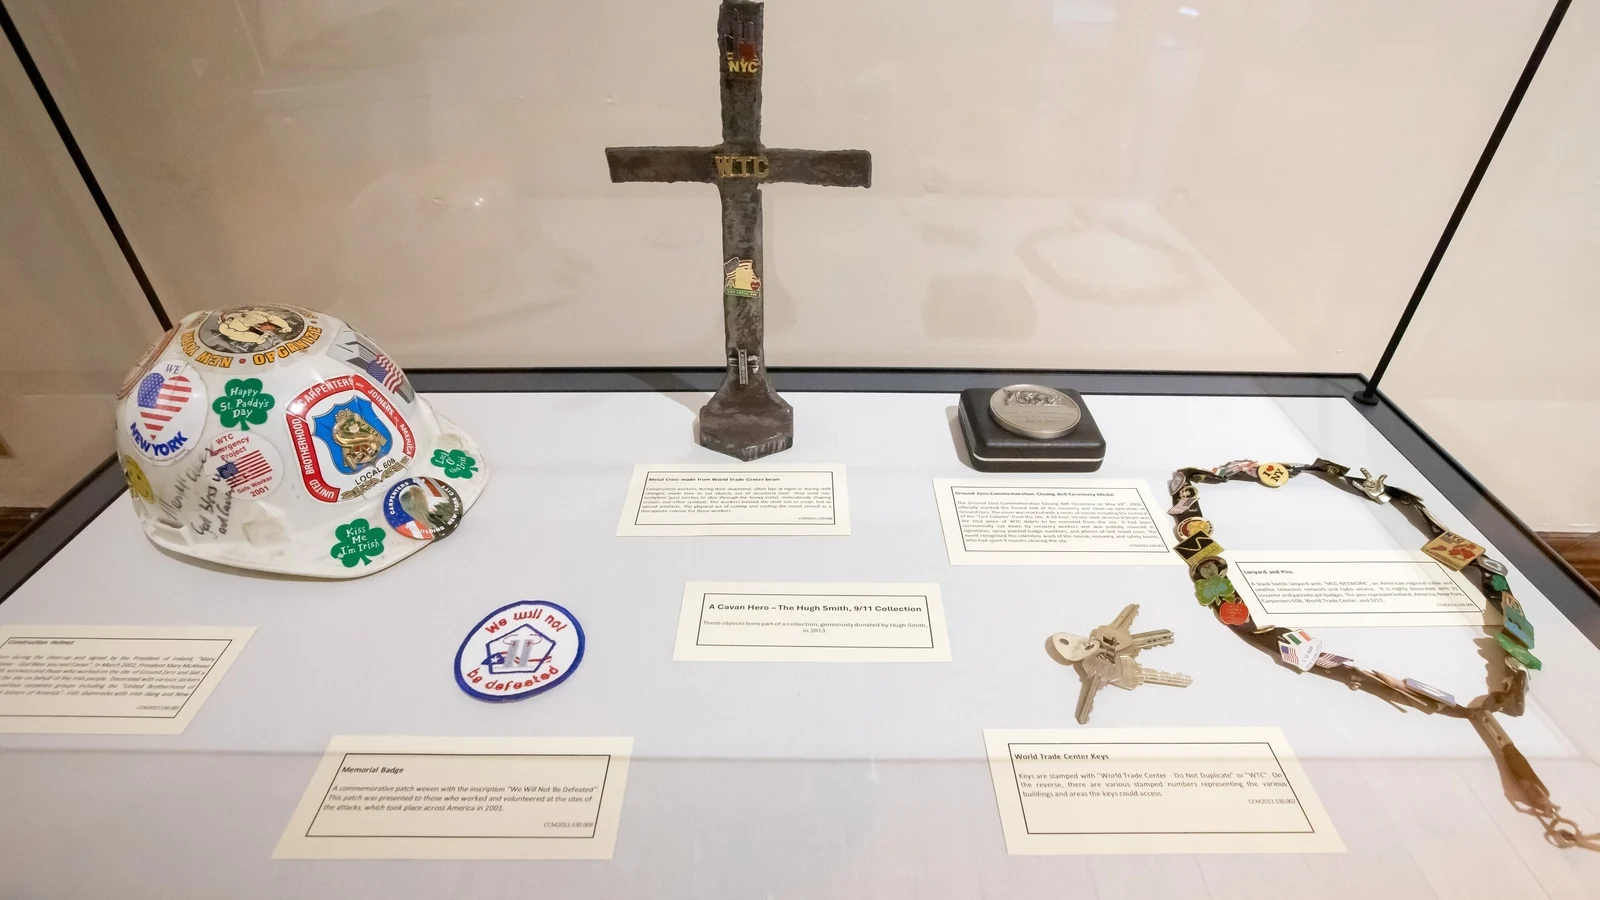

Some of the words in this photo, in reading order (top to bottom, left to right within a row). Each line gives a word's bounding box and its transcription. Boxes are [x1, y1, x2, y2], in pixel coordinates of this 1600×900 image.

[728, 60, 758, 73] NYC
[715, 155, 770, 178] WTC
[166, 364, 181, 374] WE
[230, 387, 259, 397] Happy
[297, 377, 354, 406] CARPENTERS
[220, 402, 233, 412] St.
[236, 398, 269, 409] Paddy's
[368, 389, 394, 415] JOINERS
[232, 408, 253, 418] Day
[130, 422, 151, 453] NEW
[150, 431, 188, 456] YORK
[216, 433, 234, 444] WTC
[292, 418, 315, 475] BROTHERHOOD
[220, 446, 247, 461] Project
[355, 466, 383, 485] LOCAL
[383, 457, 396, 468] 608
[1270, 468, 1284, 482] NY
[250, 476, 273, 488] Worker
[250, 486, 270, 497] 2001
[309, 479, 335, 499] UNITED
[441, 485, 454, 496] CITY
[389, 481, 409, 515] CARPENTERS
[346, 525, 366, 538] Kiss
[352, 535, 368, 545] Me
[341, 546, 356, 556] I'm
[358, 539, 380, 552] Irish
[796, 604, 821, 613] Hugh
[822, 604, 852, 612] Smith,
[485, 618, 508, 634] We
[513, 608, 543, 621] will
[544, 614, 568, 632] not
[467, 667, 483, 684] be
[485, 665, 559, 691] defeated
[1013, 753, 1039, 761] World
[1090, 753, 1110, 761] Keys
[340, 766, 380, 774] Memorial
[380, 766, 405, 775] Badge
[1018, 773, 1035, 781] Keys
[1048, 772, 1079, 780] stamped
[394, 785, 415, 793] patch
[440, 785, 456, 793] with
[456, 785, 470, 793] the
[469, 786, 506, 794] inscription
[523, 785, 538, 793] Will
[1022, 790, 1054, 799] buildings
[1054, 790, 1069, 798] and
[1101, 790, 1119, 798] keys
[342, 794, 364, 802] patch
[377, 794, 415, 803] presented
[422, 794, 443, 802] those
[443, 794, 460, 802] who
[460, 794, 489, 802] worked
[487, 794, 503, 802] and
[503, 795, 546, 803] volunteered
[554, 795, 567, 803] the
[567, 795, 584, 803] sites
[335, 804, 362, 812] attacks,
[402, 804, 423, 812] place
[445, 804, 476, 812] America
[484, 804, 505, 812] 2001.
